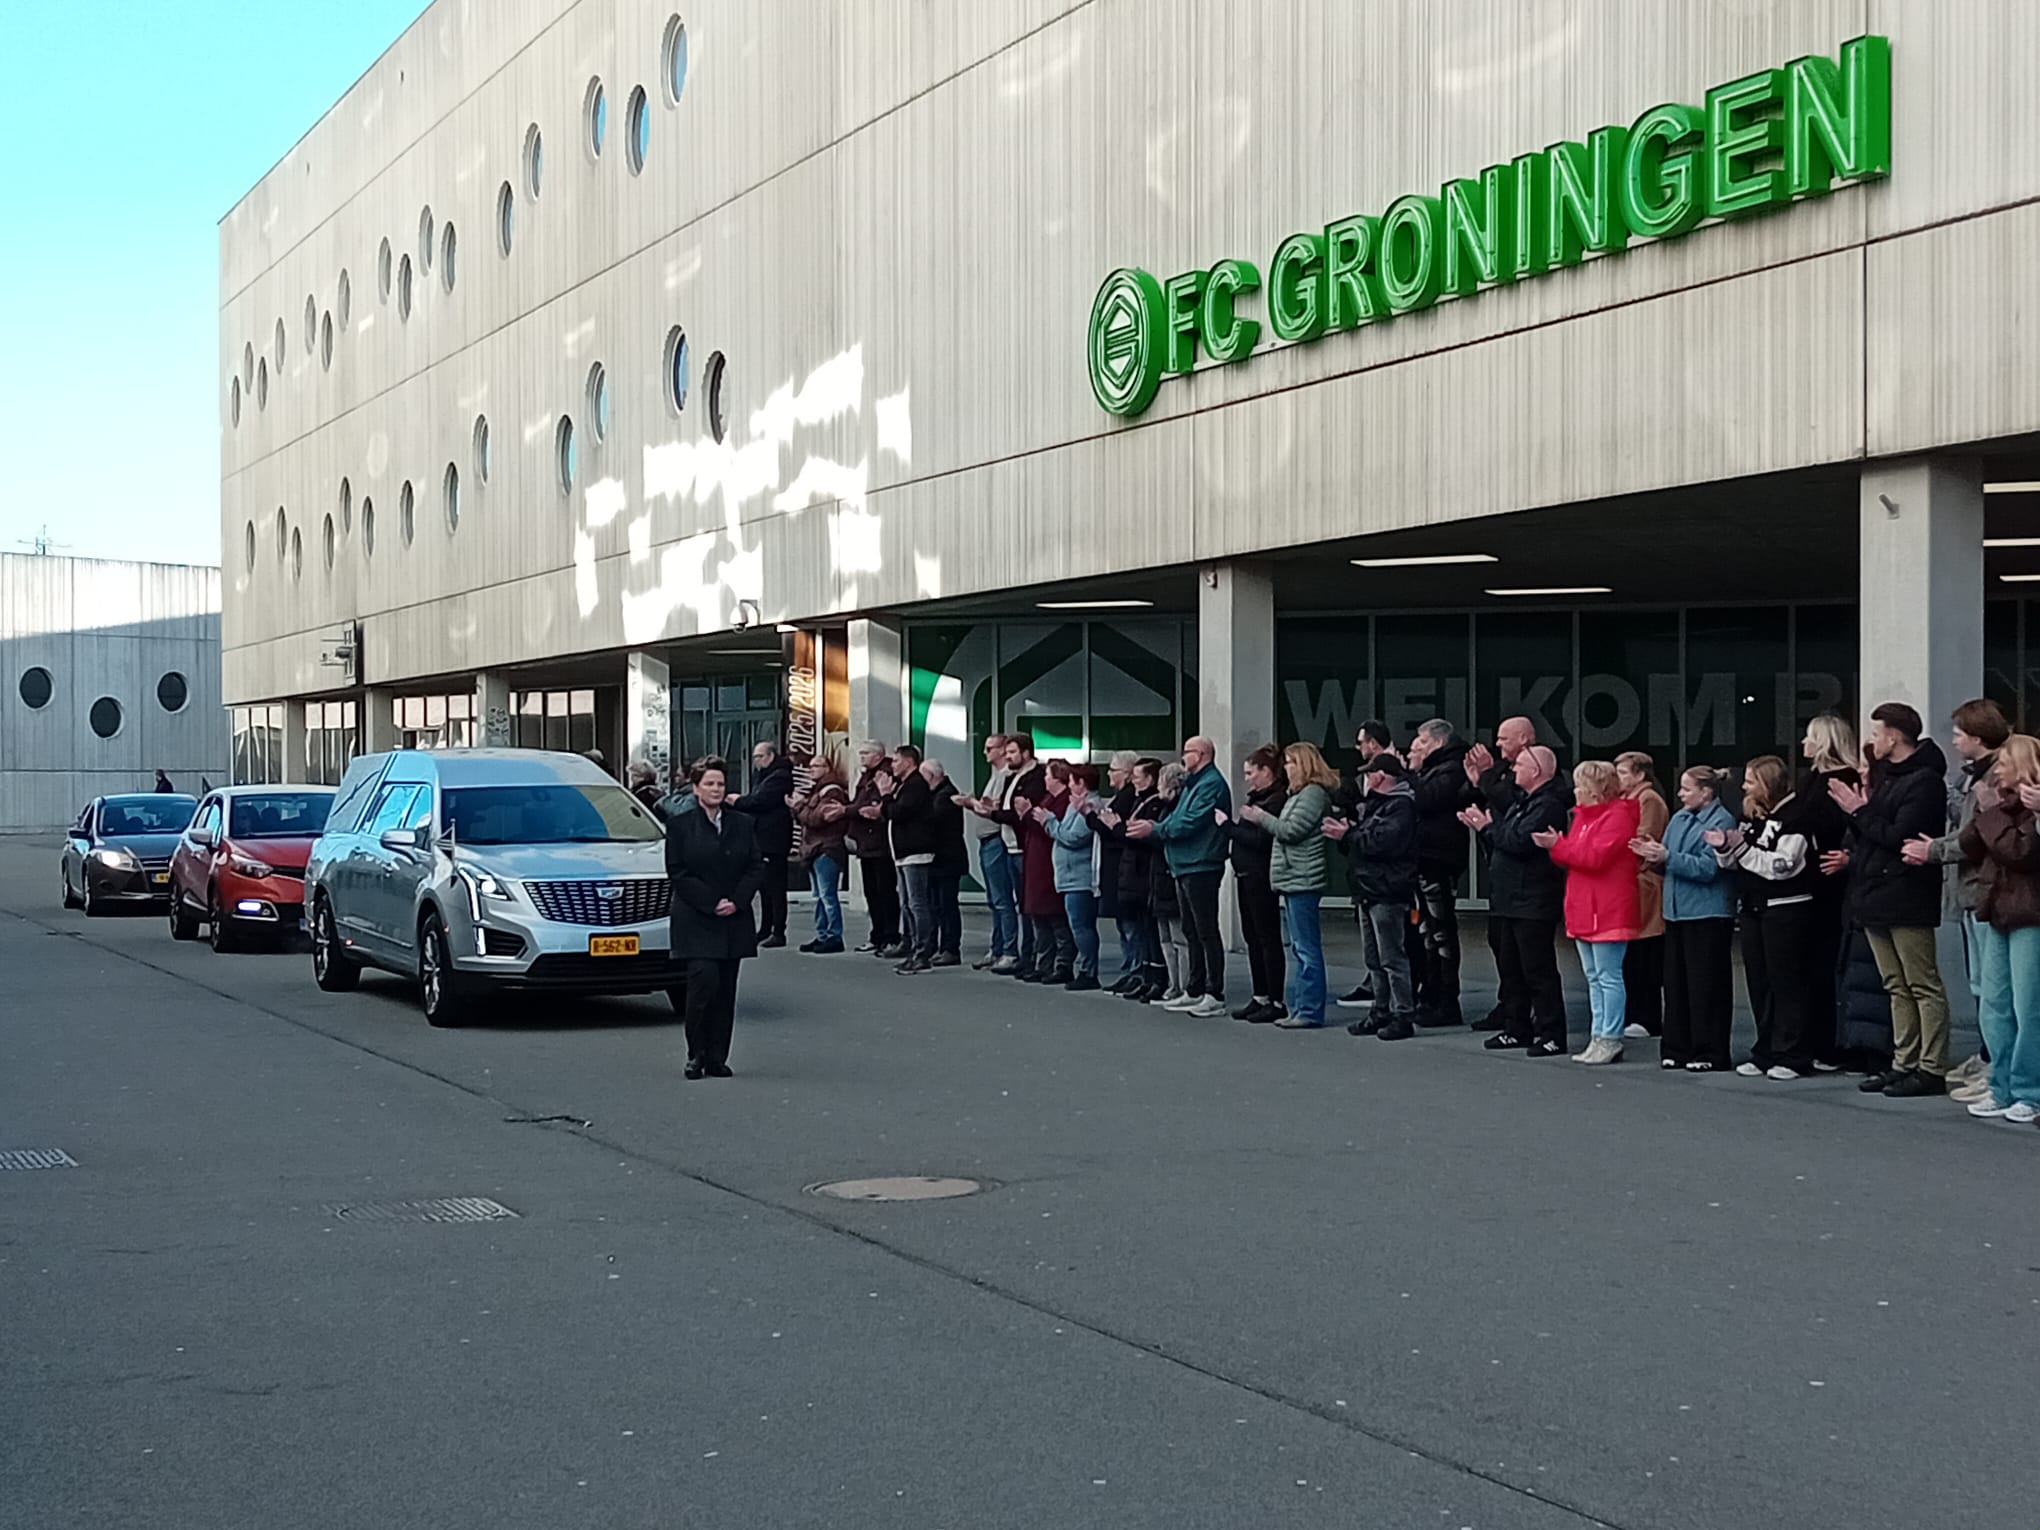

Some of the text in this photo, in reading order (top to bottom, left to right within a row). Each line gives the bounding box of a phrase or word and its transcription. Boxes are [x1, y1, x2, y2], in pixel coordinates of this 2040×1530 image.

[1164, 35, 1890, 375] FC GRONINGEN
[787, 665, 816, 756] 2025/2026
[1284, 671, 1738, 748] WELKOM
